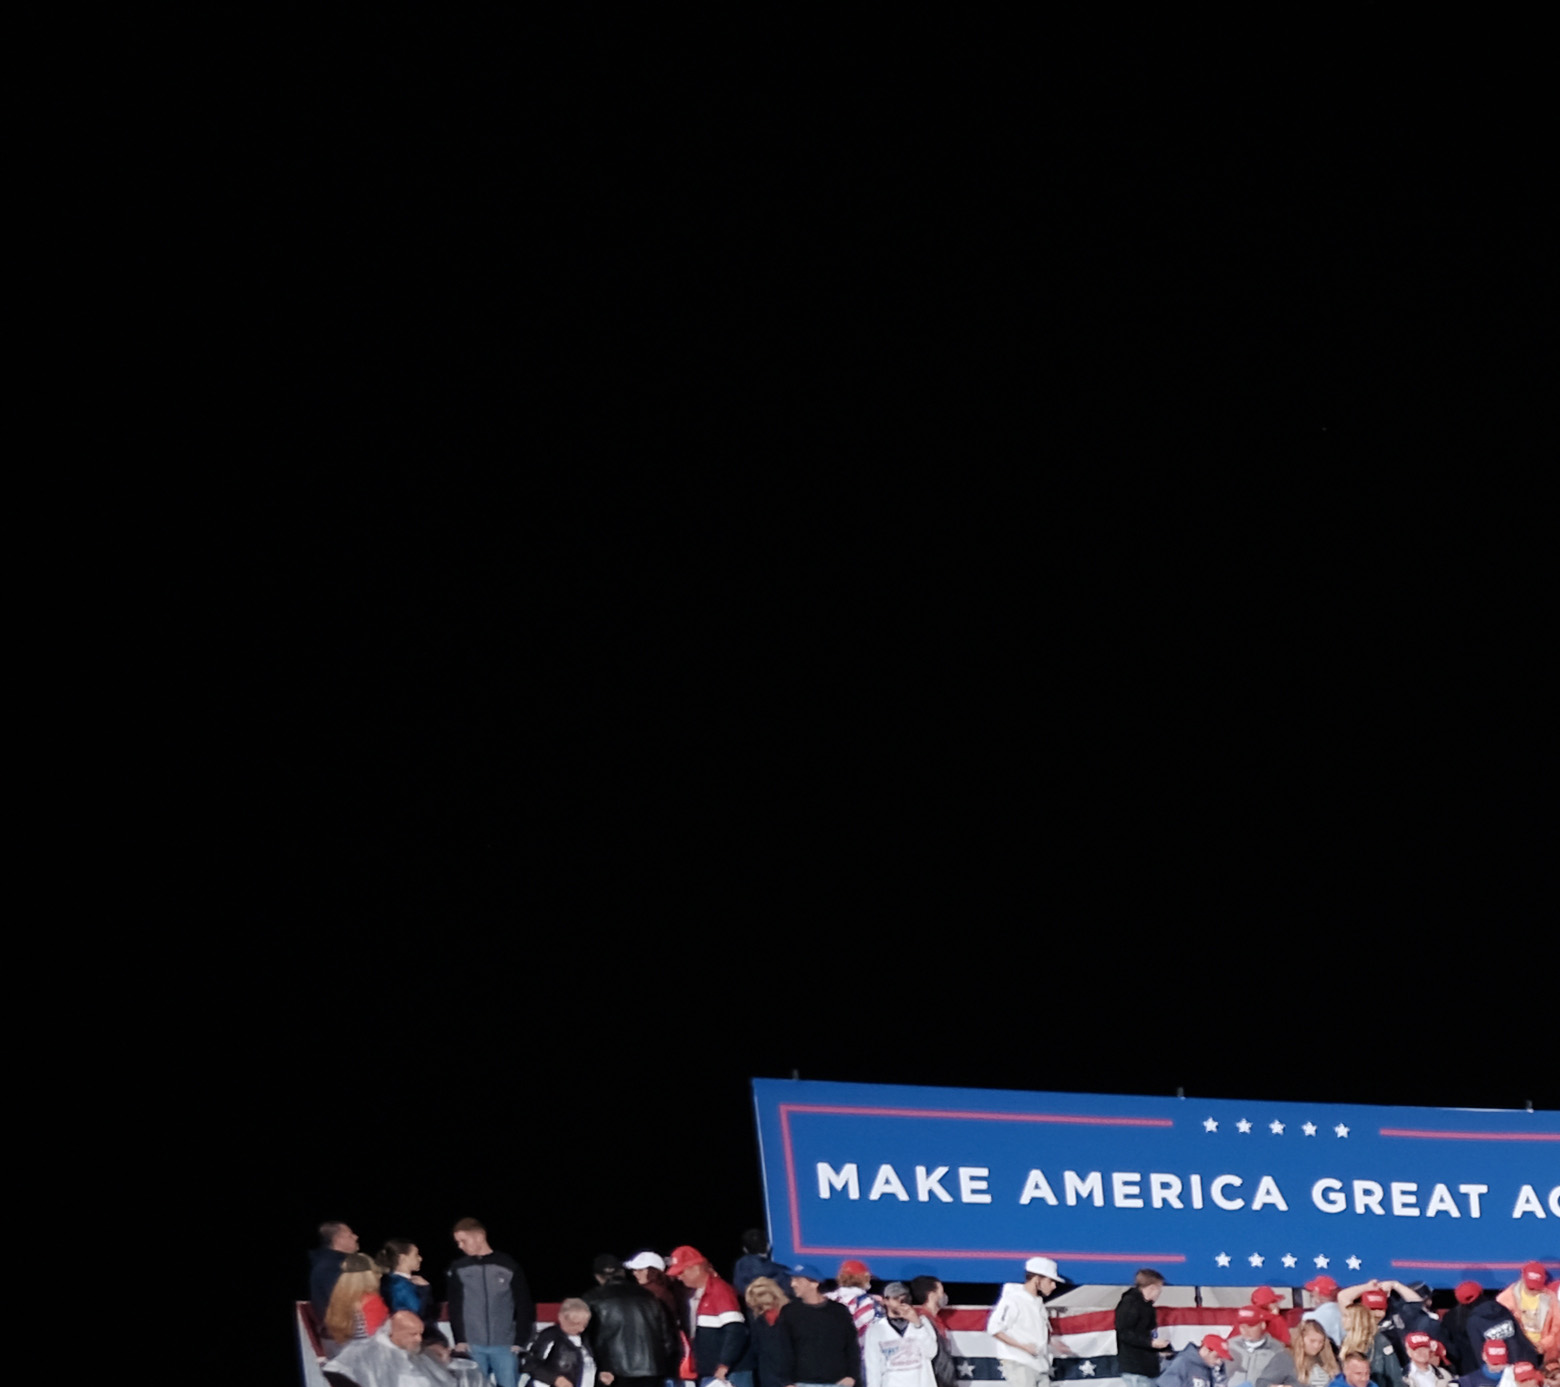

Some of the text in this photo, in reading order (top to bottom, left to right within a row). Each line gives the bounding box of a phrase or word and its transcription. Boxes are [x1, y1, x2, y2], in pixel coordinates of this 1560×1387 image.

[816, 1162, 993, 1204] MAKE
[1019, 1169, 1289, 1211] AMERICA
[1311, 1178, 1489, 1218] GREAT
